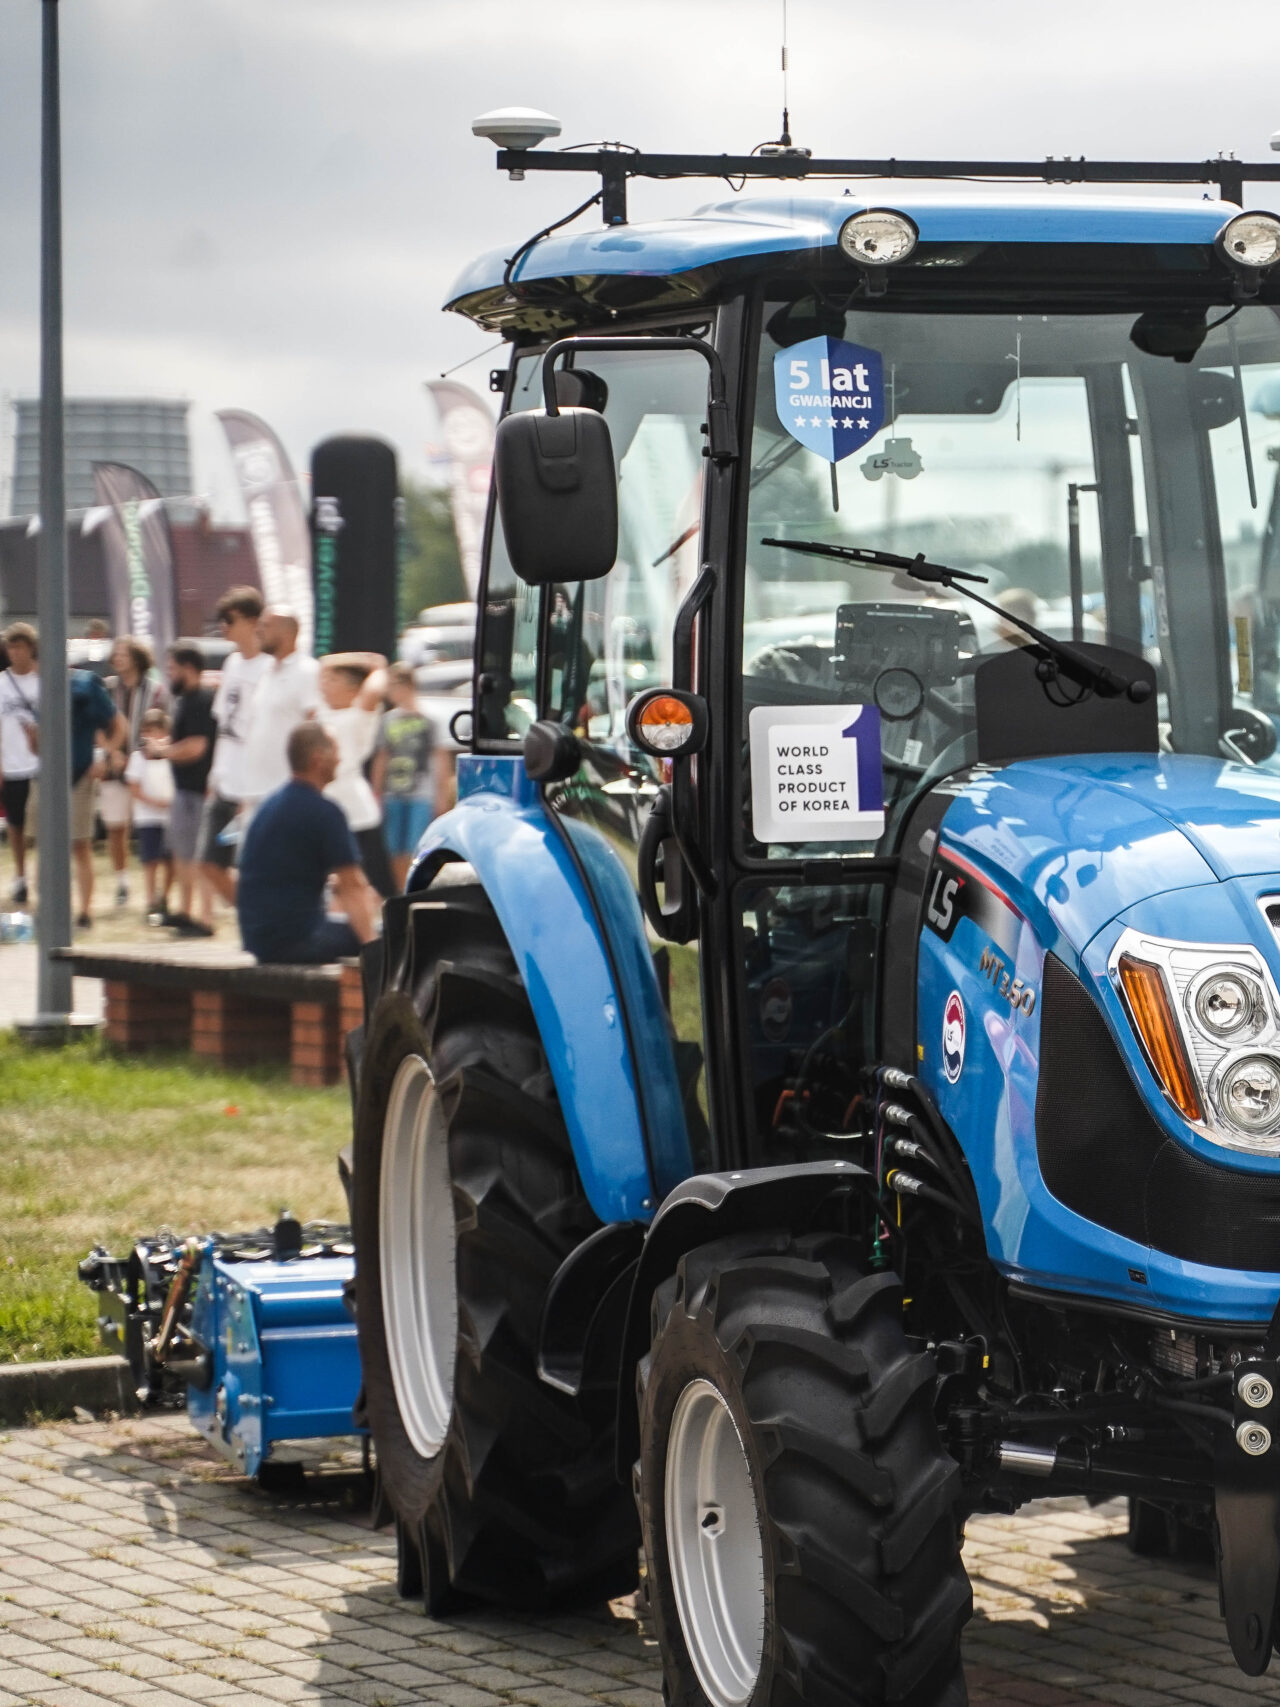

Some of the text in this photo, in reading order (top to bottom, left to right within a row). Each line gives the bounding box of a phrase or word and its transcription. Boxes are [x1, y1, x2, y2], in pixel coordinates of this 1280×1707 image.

[789, 358, 870, 392] 5 lat
[789, 395, 873, 409] GWARANCJI
[873, 458, 889, 468] LS
[776, 746, 829, 757] WORLD
[777, 764, 823, 775] CLASS
[778, 781, 847, 793] PRODUCT
[779, 800, 850, 811] OF KOREA
[927, 870, 959, 931] LS
